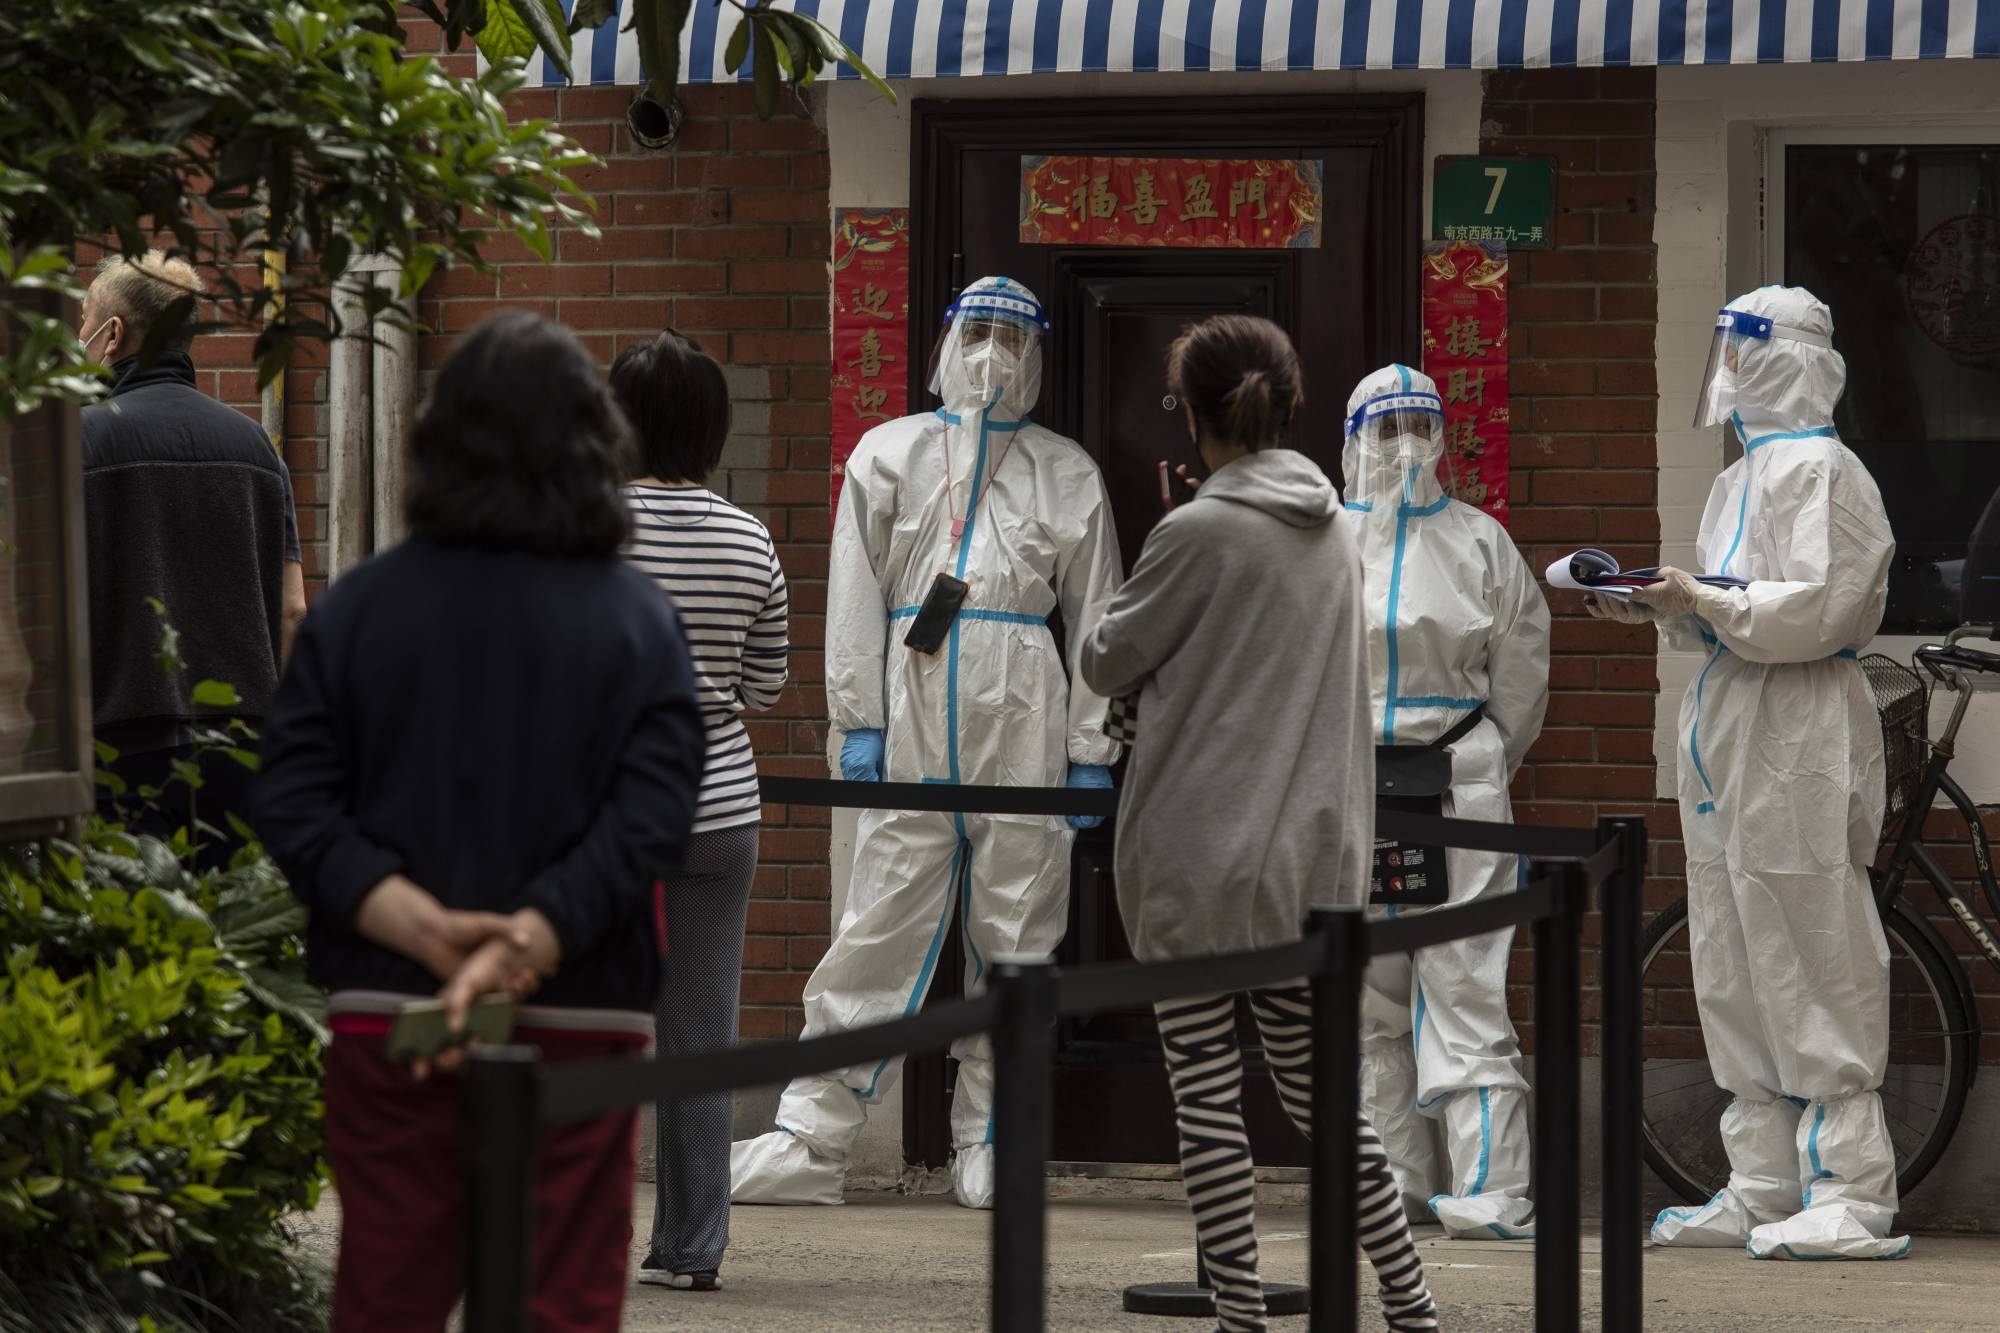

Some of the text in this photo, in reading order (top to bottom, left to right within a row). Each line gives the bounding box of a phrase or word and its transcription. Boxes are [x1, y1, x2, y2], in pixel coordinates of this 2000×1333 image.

[1072, 168, 1269, 225] 福喜盈門
[1484, 167, 1507, 215] 7
[1444, 225, 1543, 242] 南京西路五九一弄
